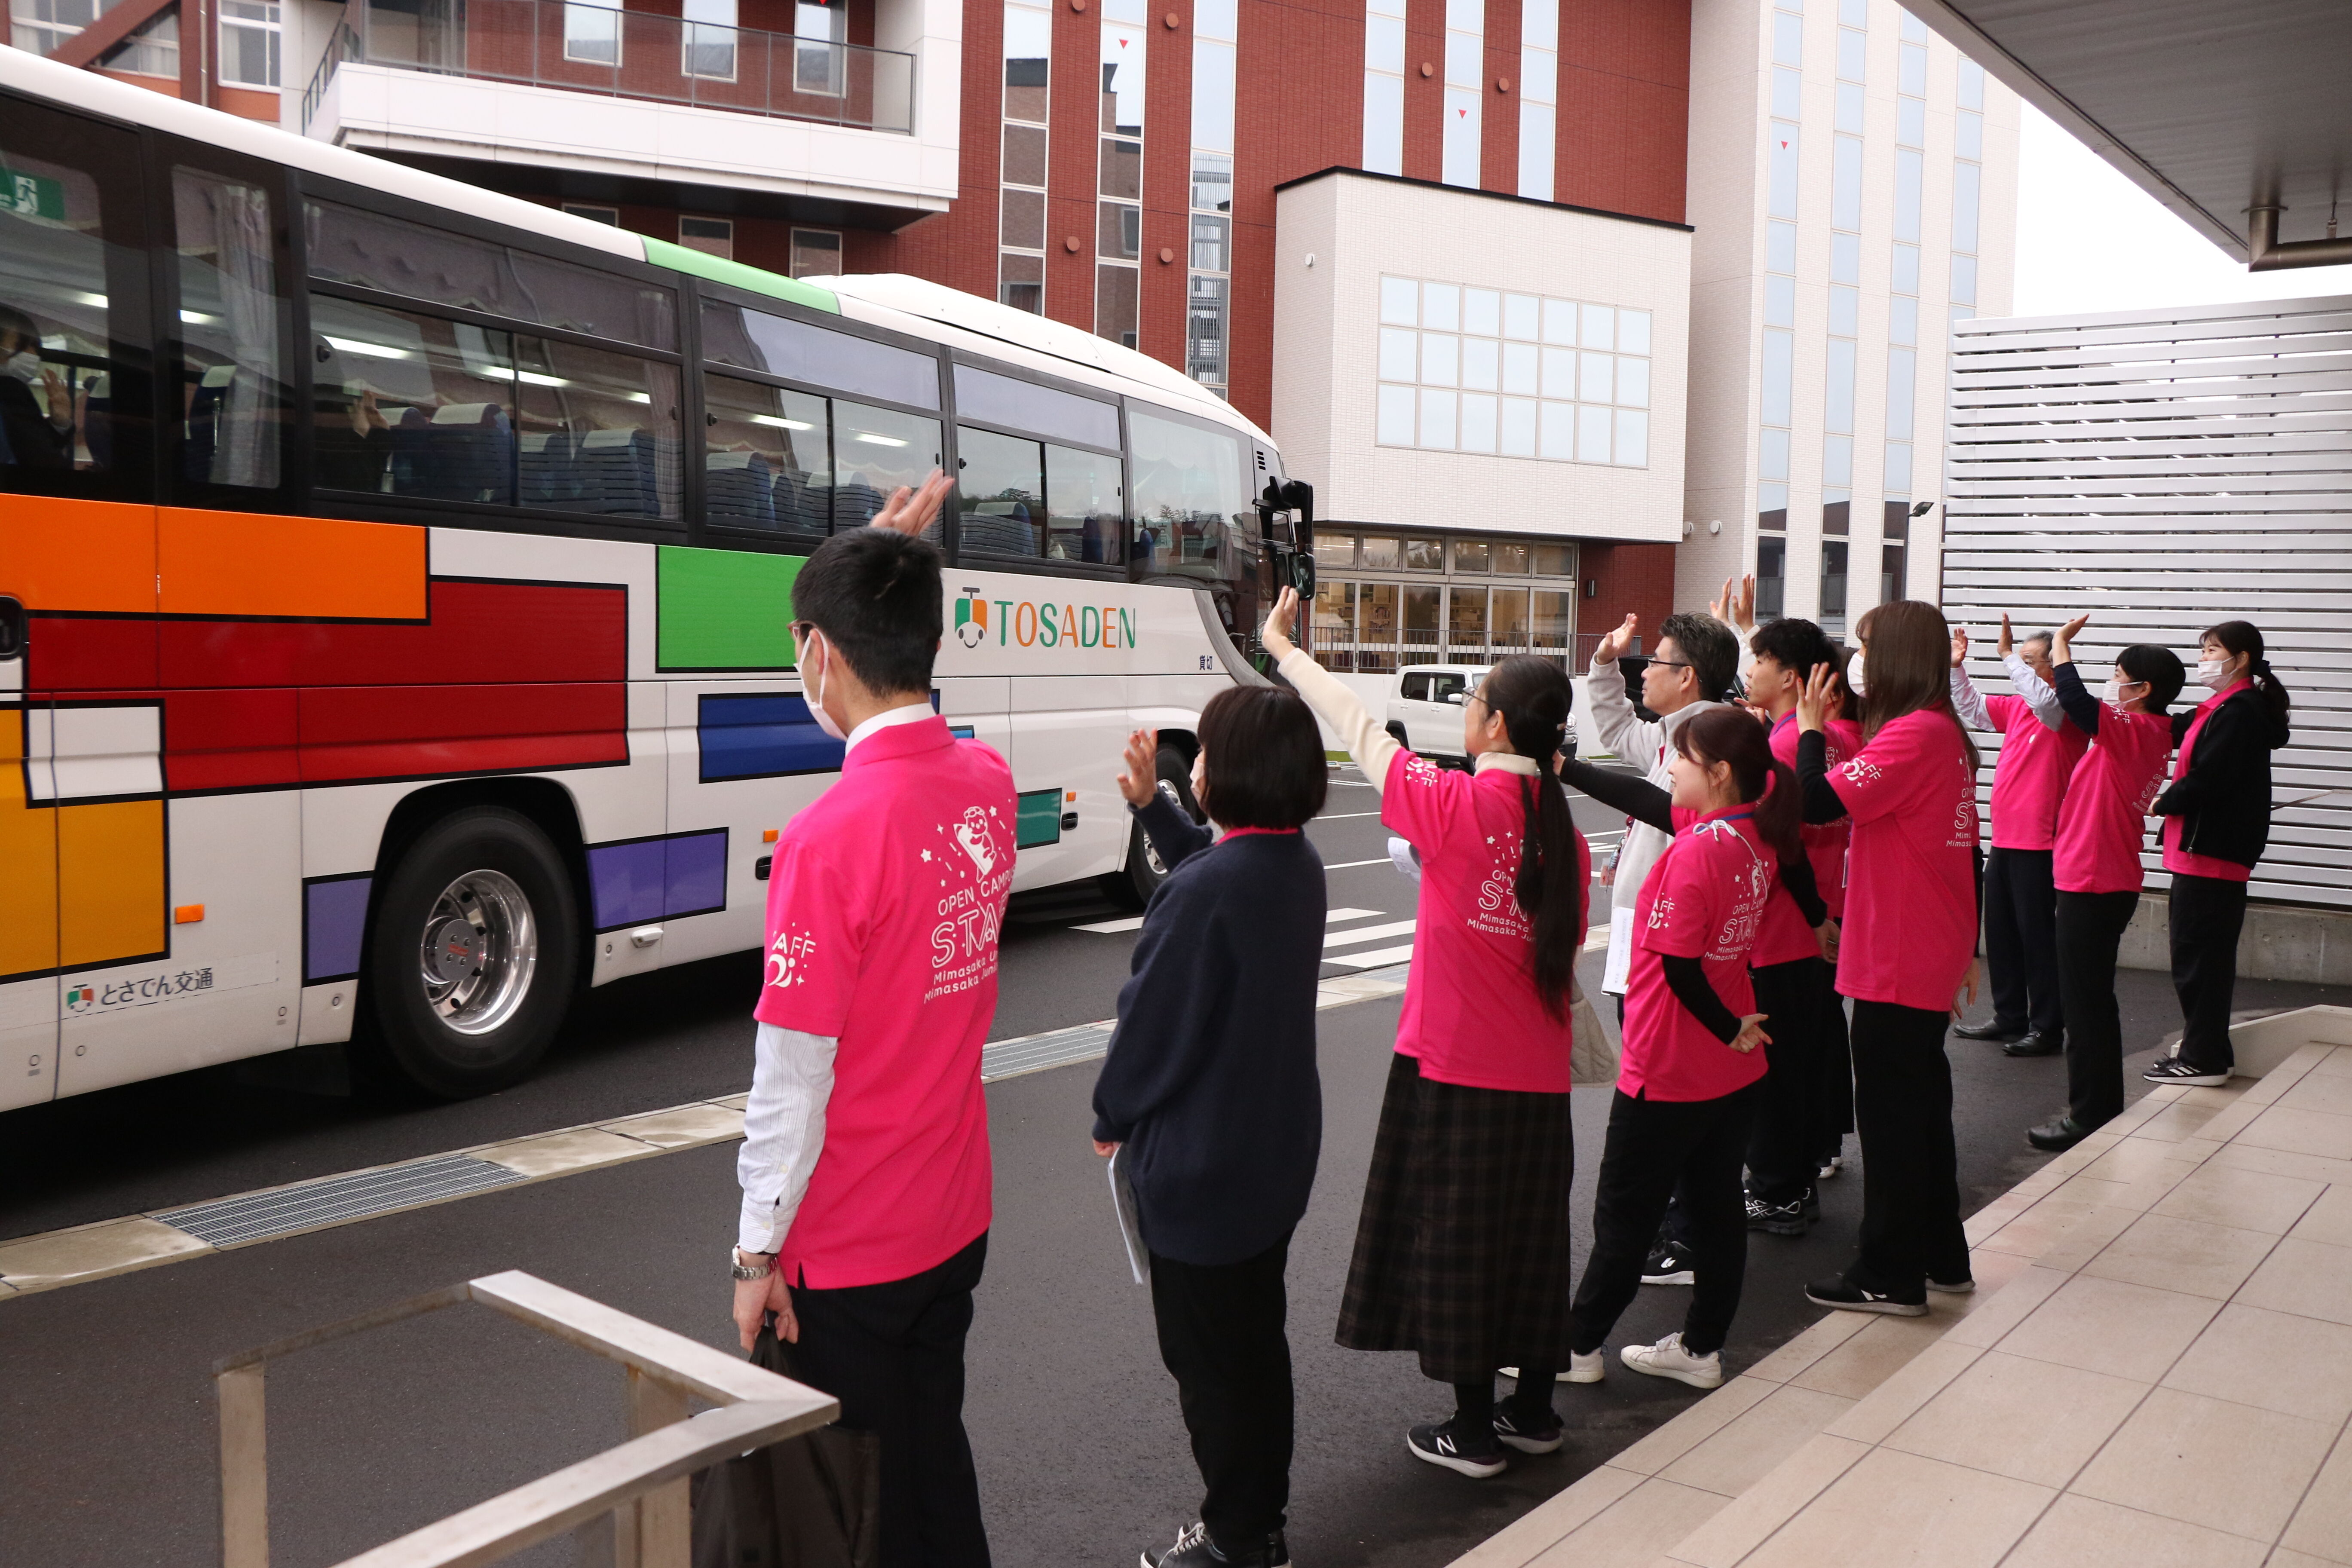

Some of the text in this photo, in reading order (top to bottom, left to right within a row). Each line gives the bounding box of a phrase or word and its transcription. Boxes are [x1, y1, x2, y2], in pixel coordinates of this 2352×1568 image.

[994, 600, 1136, 649] TOSADEN
[1200, 655, 1213, 671] 貸切
[938, 886, 975, 916] OPEN
[1467, 919, 1517, 936] Mimasaka
[1479, 913, 1529, 933] Mimasaka
[1704, 952, 1737, 961] Mimasaka
[934, 957, 986, 985] Mimasaka
[101, 967, 214, 1006] とさでん交通
[924, 976, 979, 1004] Mimasaka
